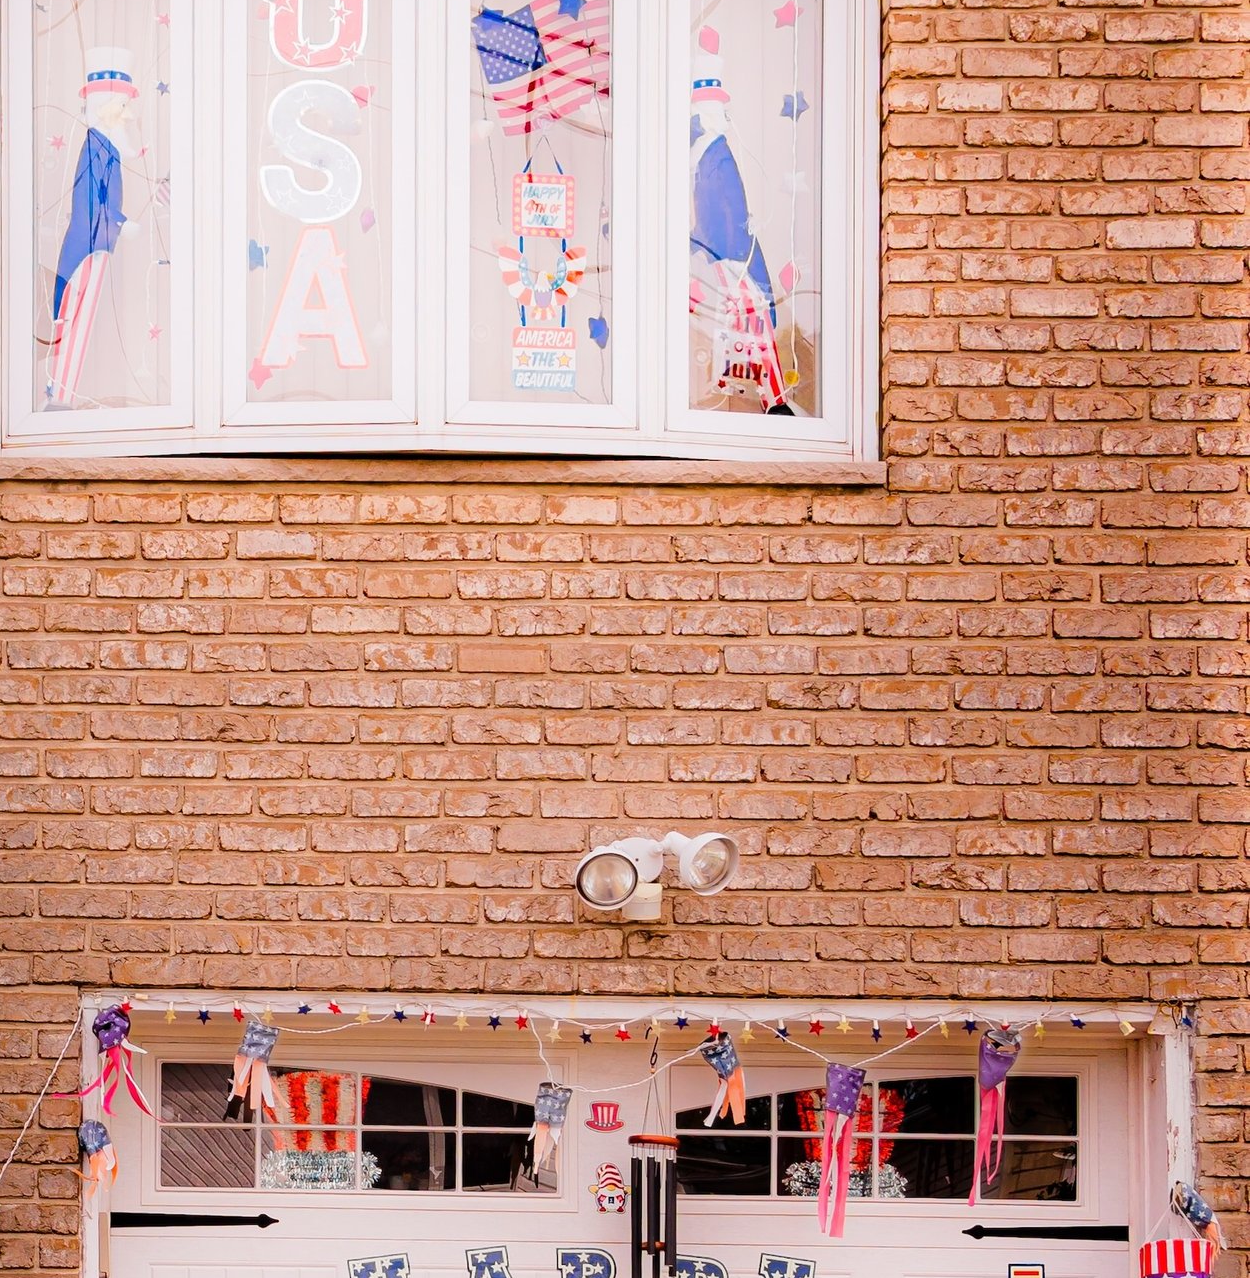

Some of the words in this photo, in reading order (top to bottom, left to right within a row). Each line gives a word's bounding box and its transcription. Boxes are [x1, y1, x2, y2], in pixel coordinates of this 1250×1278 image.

[523, 185, 565, 201] HAPPY
[524, 198, 548, 215] 4TH
[549, 203, 562, 214] OF
[526, 214, 559, 227] JULY
[515, 329, 574, 348] AMERICA
[530, 351, 558, 368] THE
[514, 371, 575, 389] BEAUTIFUL
